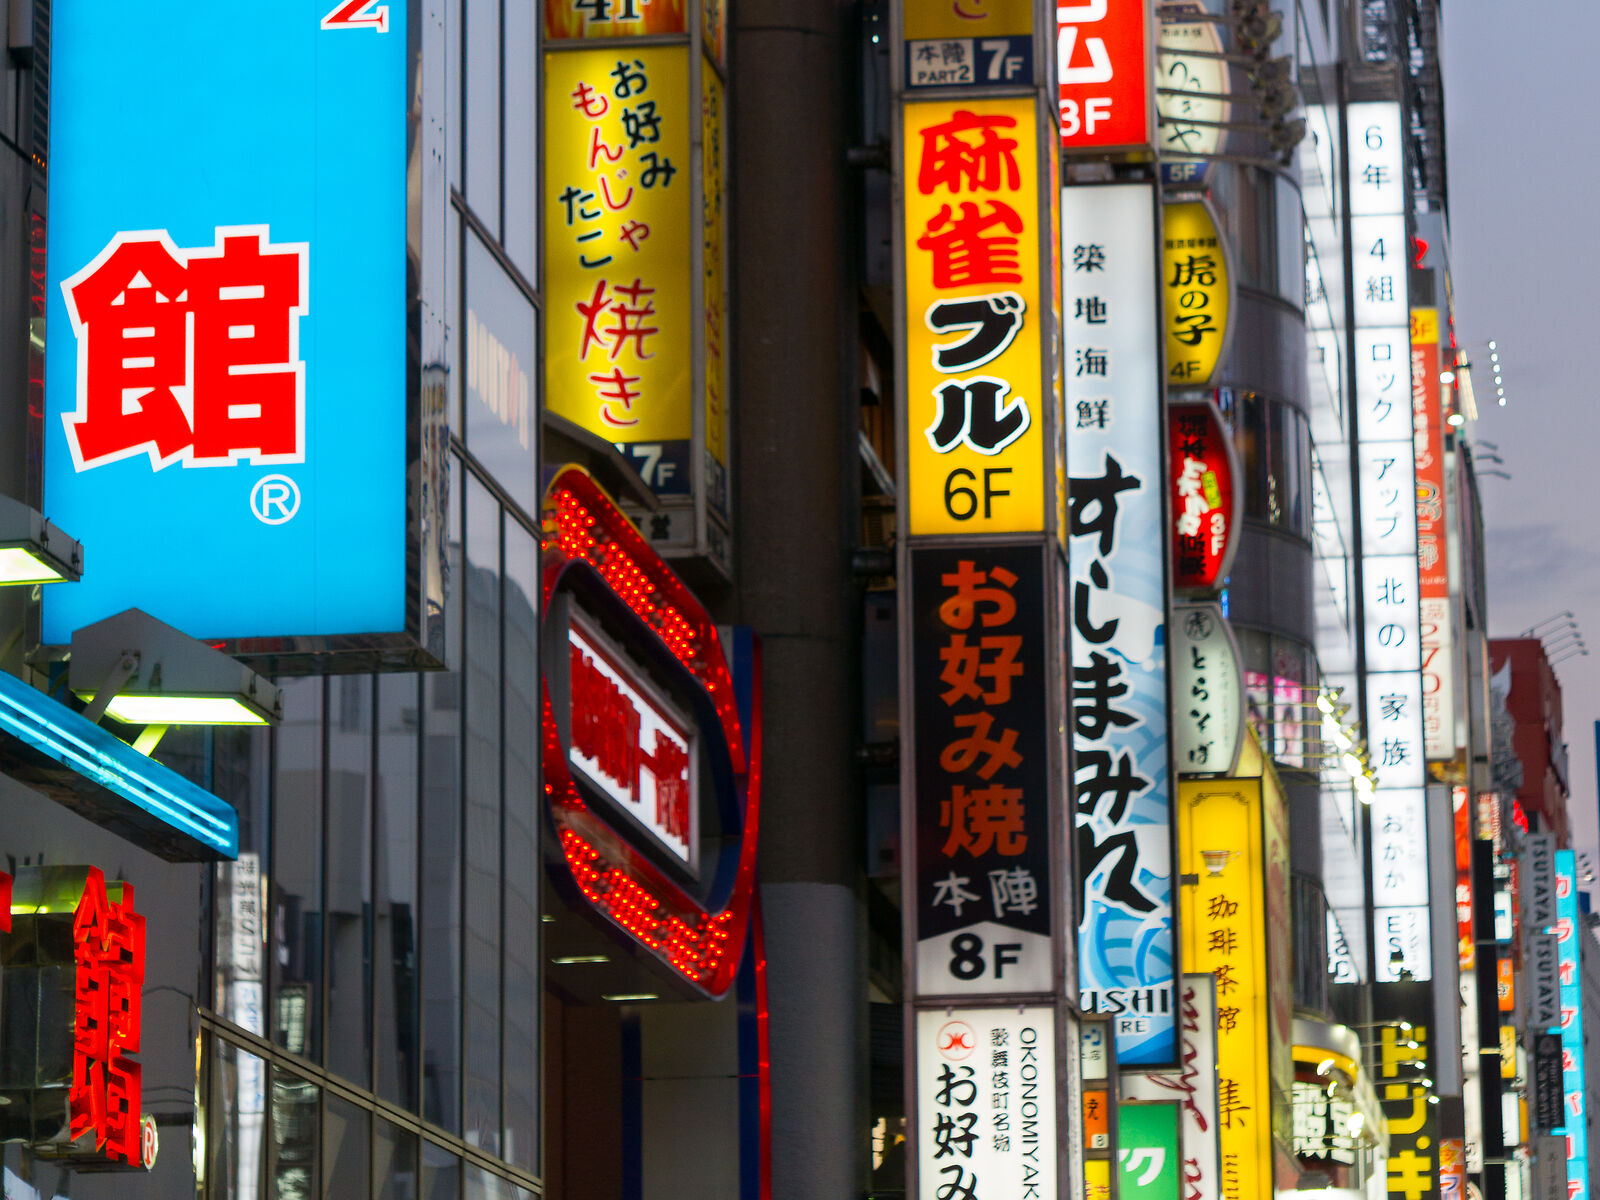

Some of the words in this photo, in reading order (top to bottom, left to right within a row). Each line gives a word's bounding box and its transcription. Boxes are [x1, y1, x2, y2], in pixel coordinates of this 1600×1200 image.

[918, 65, 970, 82] PART2
[980, 40, 1025, 82] 7F
[611, 59, 677, 190] お好み
[1059, 98, 1113, 138] 3F
[571, 81, 652, 253] もんじゃ
[1170, 163, 1198, 182] 5F
[558, 186, 613, 270] たこ
[1168, 255, 1217, 347] 虎の子
[575, 277, 660, 427] 焼き
[1073, 244, 1111, 431] 築地海鮮
[1170, 361, 1201, 379] 4F
[943, 467, 1014, 522] 6F
[938, 560, 1029, 859] お好み焼
[932, 865, 1039, 918] 本陣
[1533, 839, 1549, 922] TSUTAYA
[949, 932, 1023, 981] 8F
[1537, 939, 1553, 1024] TSUTAYA
[1080, 988, 1170, 1014] USHI
